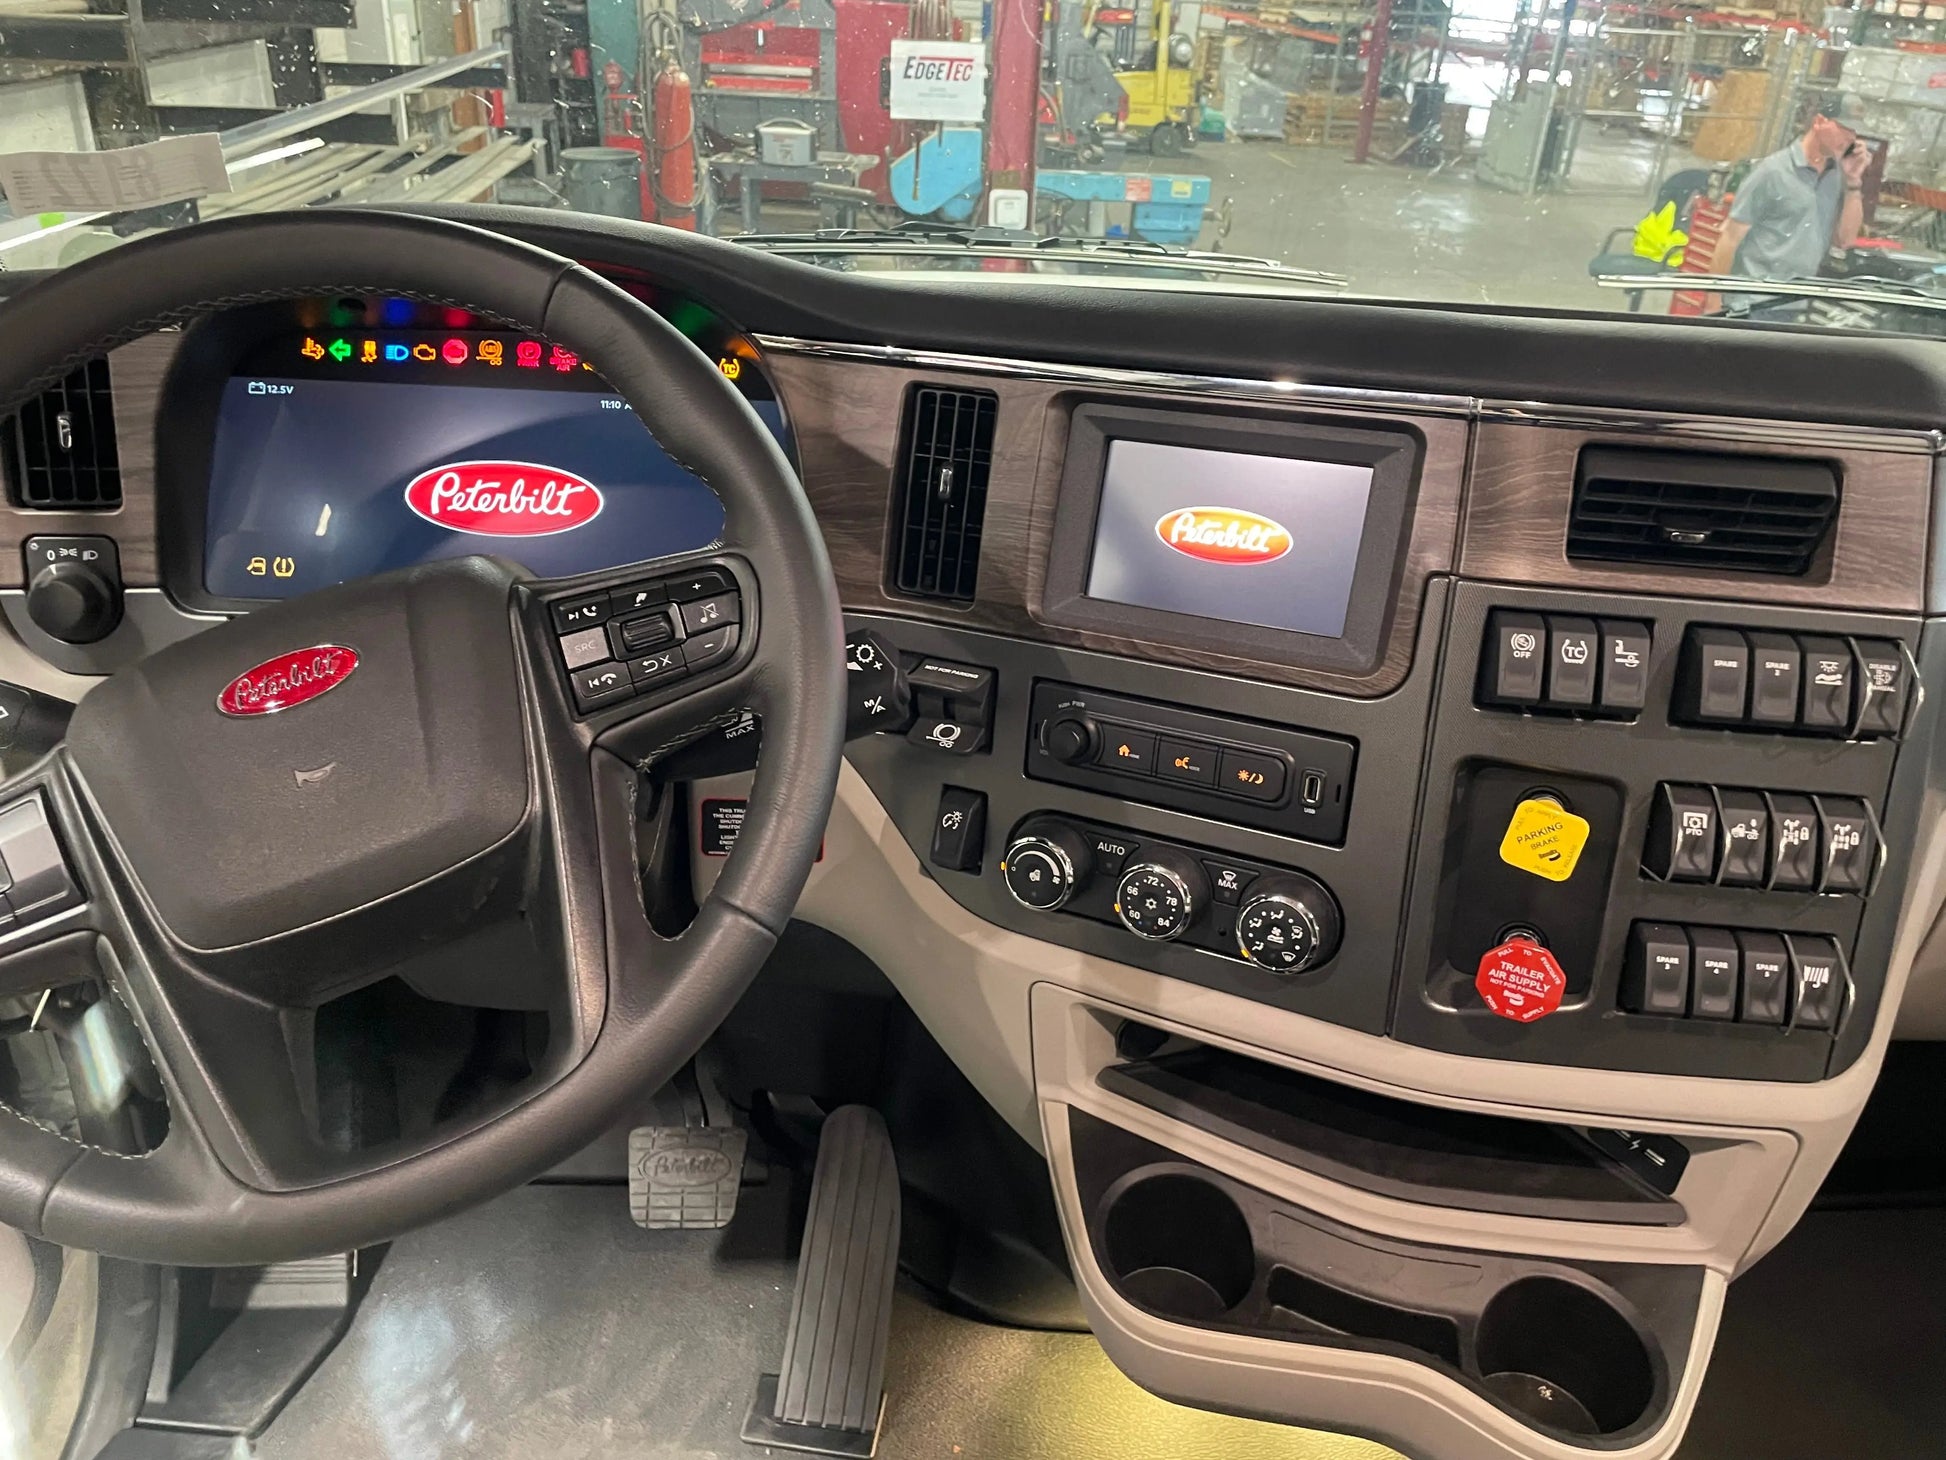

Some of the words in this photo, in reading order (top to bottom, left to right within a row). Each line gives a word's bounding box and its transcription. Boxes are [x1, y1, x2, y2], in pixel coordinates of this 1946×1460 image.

[723, 363, 736, 374] TC
[267, 384, 294, 395] 12.5V
[600, 399, 621, 410] 11:10
[430, 472, 587, 516] Peterbilt
[1171, 512, 1281, 553] Peterbilt
[574, 640, 597, 653] SRC
[1566, 646, 1583, 659] TC
[1513, 650, 1532, 659] OFF
[1714, 659, 1738, 668] SPARE
[1765, 661, 1790, 670] SPARE
[951, 669, 979, 679] PARKING
[235, 651, 343, 711] Peterbilt
[725, 725, 755, 740] MAX
[1516, 821, 1564, 845] PARKING
[1685, 828, 1703, 837] PTO
[1530, 835, 1560, 850] BRAKE
[1097, 841, 1125, 857] AUTO
[1146, 876, 1158, 887] 72
[1217, 878, 1238, 891] MAX
[1126, 885, 1138, 897] 66
[1165, 896, 1178, 908] 78
[1128, 910, 1141, 921] 60
[1157, 917, 1170, 928] 84
[1497, 947, 1514, 958] PULL
[1656, 956, 1680, 965] SPARE
[1705, 960, 1729, 970] SPARE
[1500, 960, 1545, 981] TRAILER
[1756, 963, 1780, 972] SPARE
[1488, 968, 1507, 980] AIR
[1508, 973, 1551, 993] SUPPLY
[1489, 977, 1503, 985] NOT
[1503, 981, 1517, 990] FOR
[1517, 985, 1545, 998] PARKING
[1485, 994, 1498, 1010] PUSH
[1505, 1008, 1515, 1016] TO
[1521, 1006, 1545, 1019] SUPPLY
